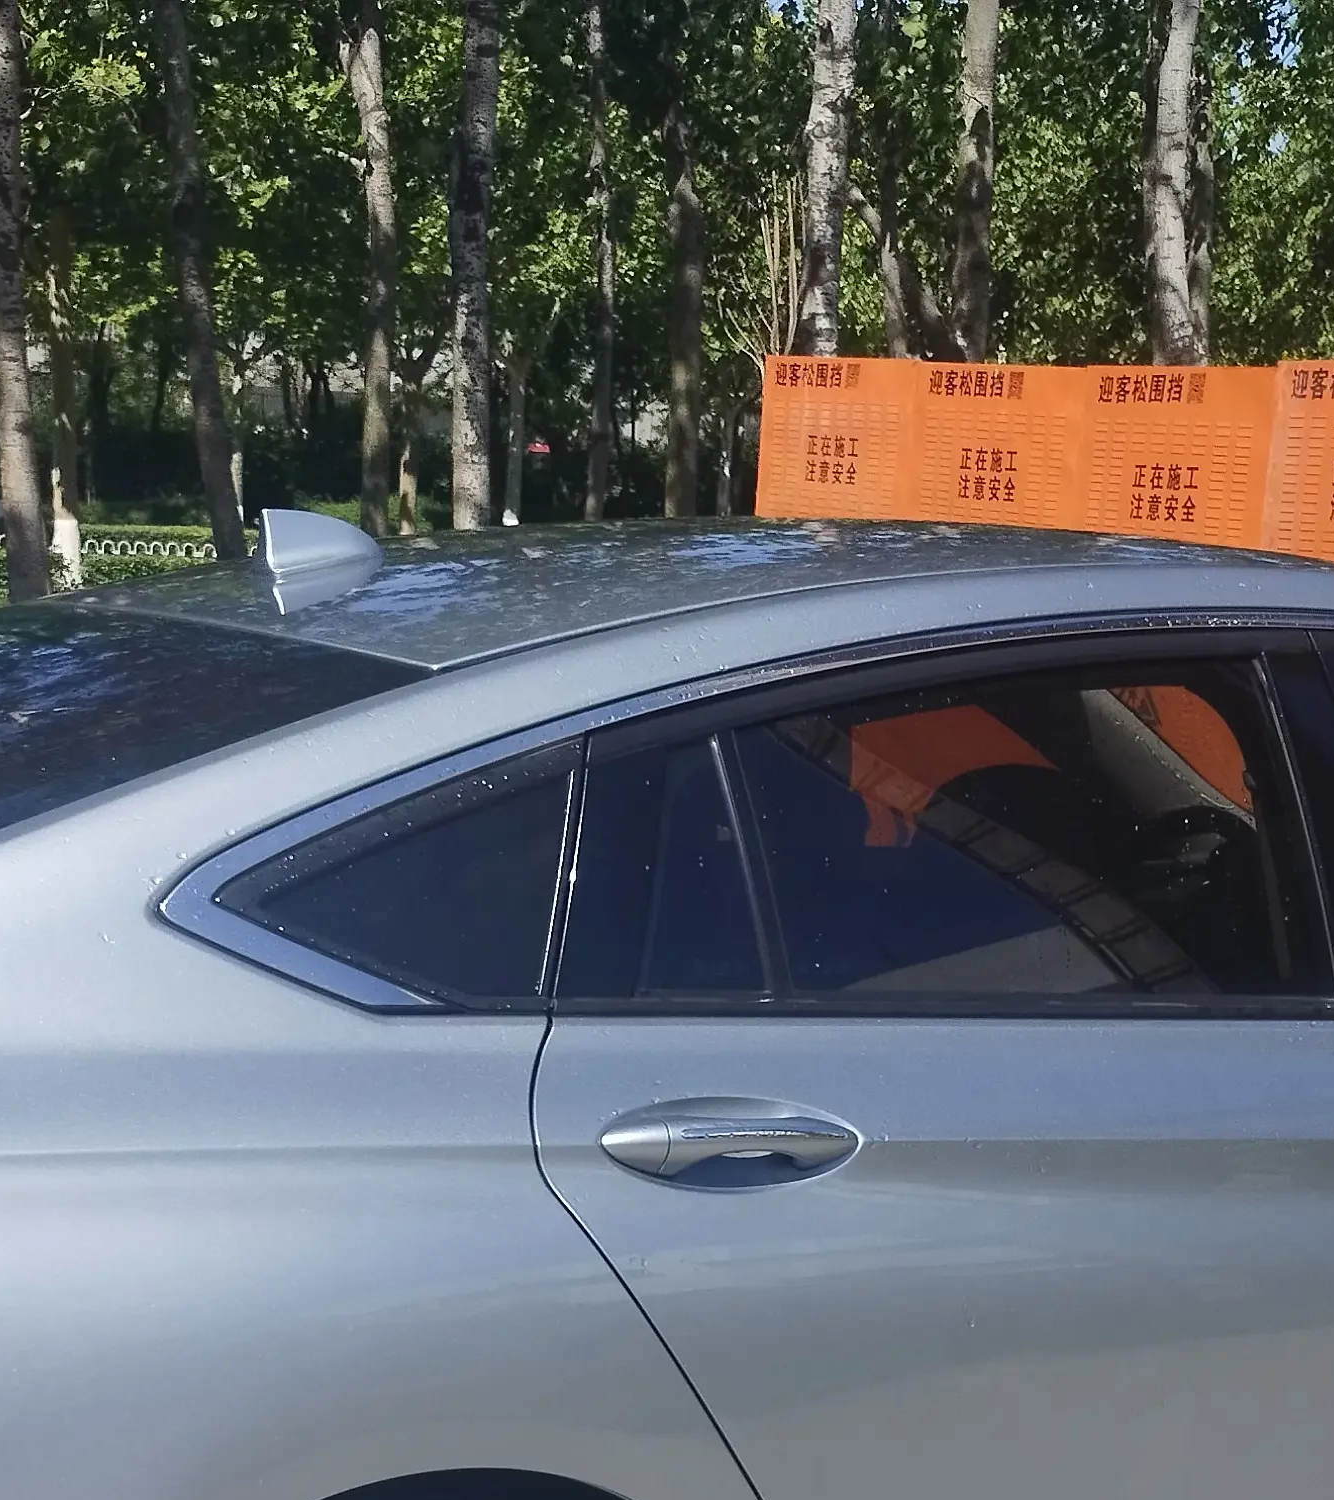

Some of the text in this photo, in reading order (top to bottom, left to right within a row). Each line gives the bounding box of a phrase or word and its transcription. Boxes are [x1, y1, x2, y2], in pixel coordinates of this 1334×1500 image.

[775, 362, 843, 388] 迎客松围挡
[928, 370, 1005, 398] 迎客松围挡
[1098, 373, 1185, 404] 迎客松围挡
[807, 434, 859, 458] 正在施工
[959, 447, 1018, 473] 正在施工
[804, 460, 858, 485] 注意安全
[1132, 463, 1199, 491] 正在施工
[958, 474, 1016, 502] 注意安全
[1130, 493, 1197, 522] 注意安全
